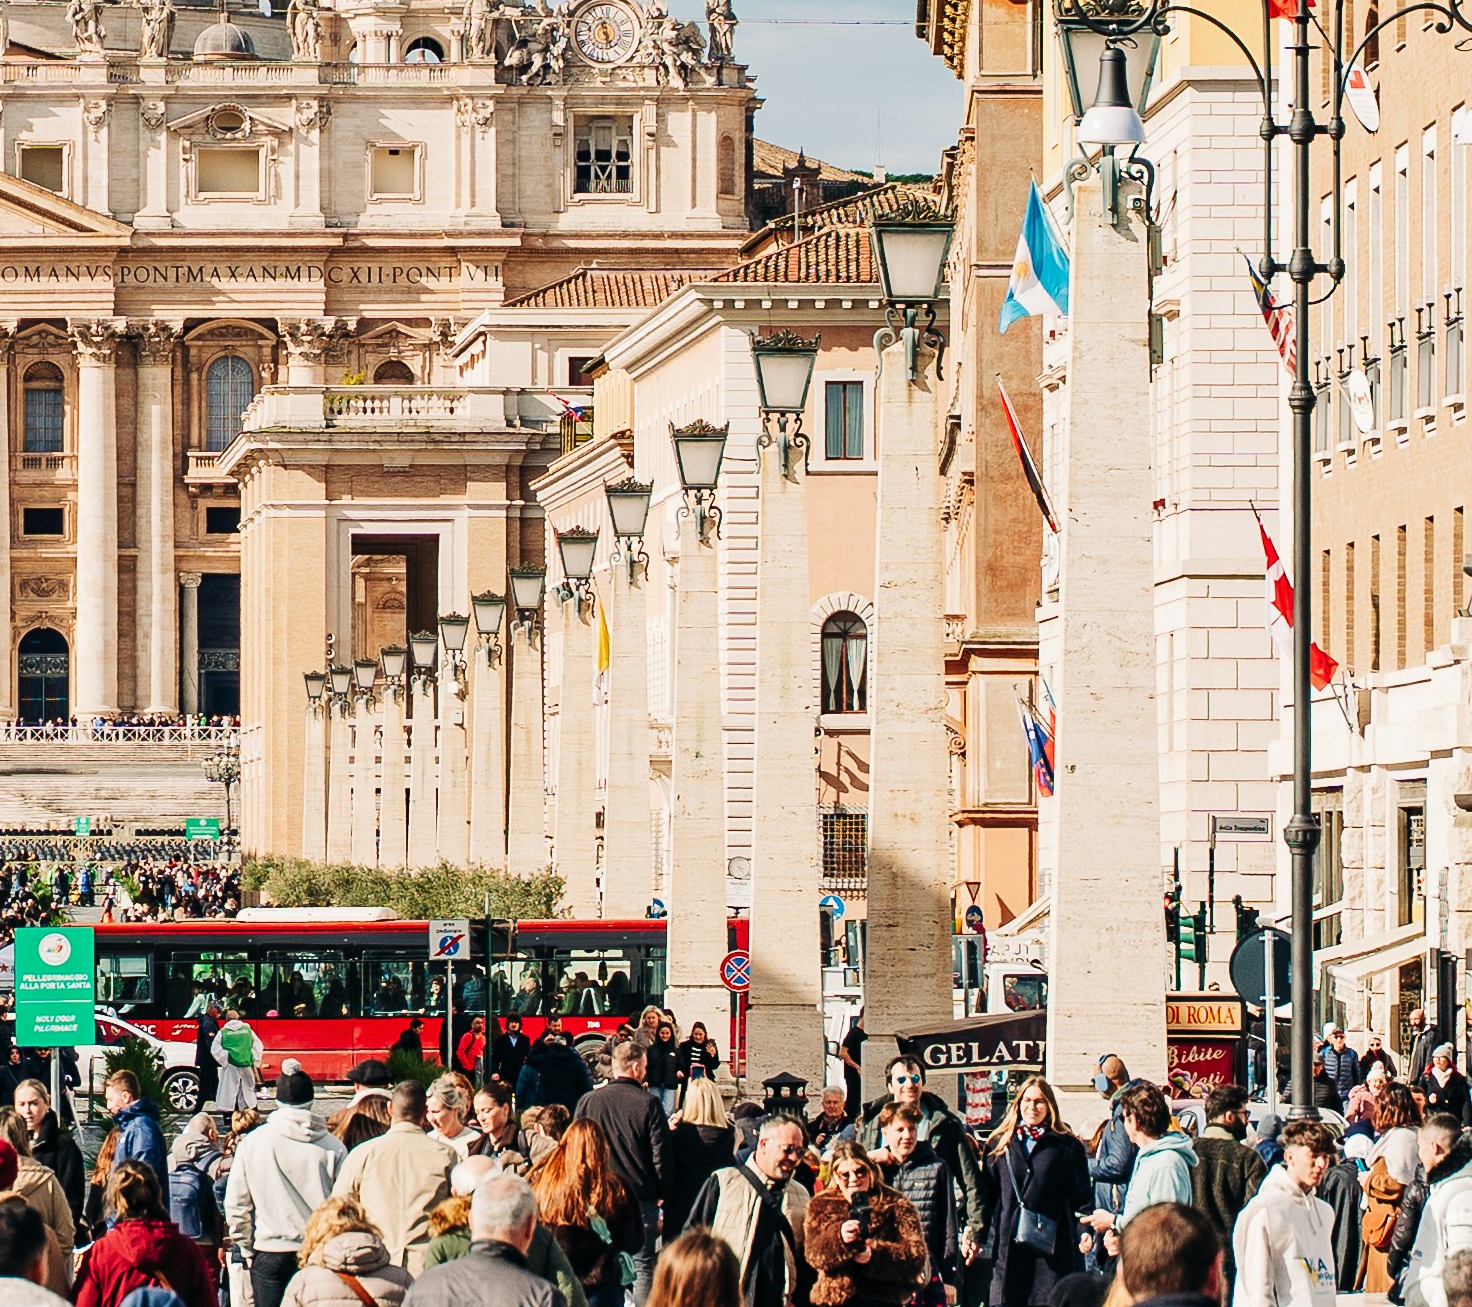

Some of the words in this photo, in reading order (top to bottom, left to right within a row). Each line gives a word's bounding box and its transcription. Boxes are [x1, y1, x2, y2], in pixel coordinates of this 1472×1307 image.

[284, 265, 383, 284] MDCXII
[466, 265, 500, 282] VII
[19, 982, 39, 990] ALLA
[40, 982, 66, 990] PORTA
[66, 981, 92, 989] SANTA
[22, 973, 89, 983] PELLEGRINAGGIO
[1187, 1005, 1235, 1025] ROMA
[923, 1040, 1046, 1066] GELATI
[1168, 1045, 1227, 1068] Bibite
